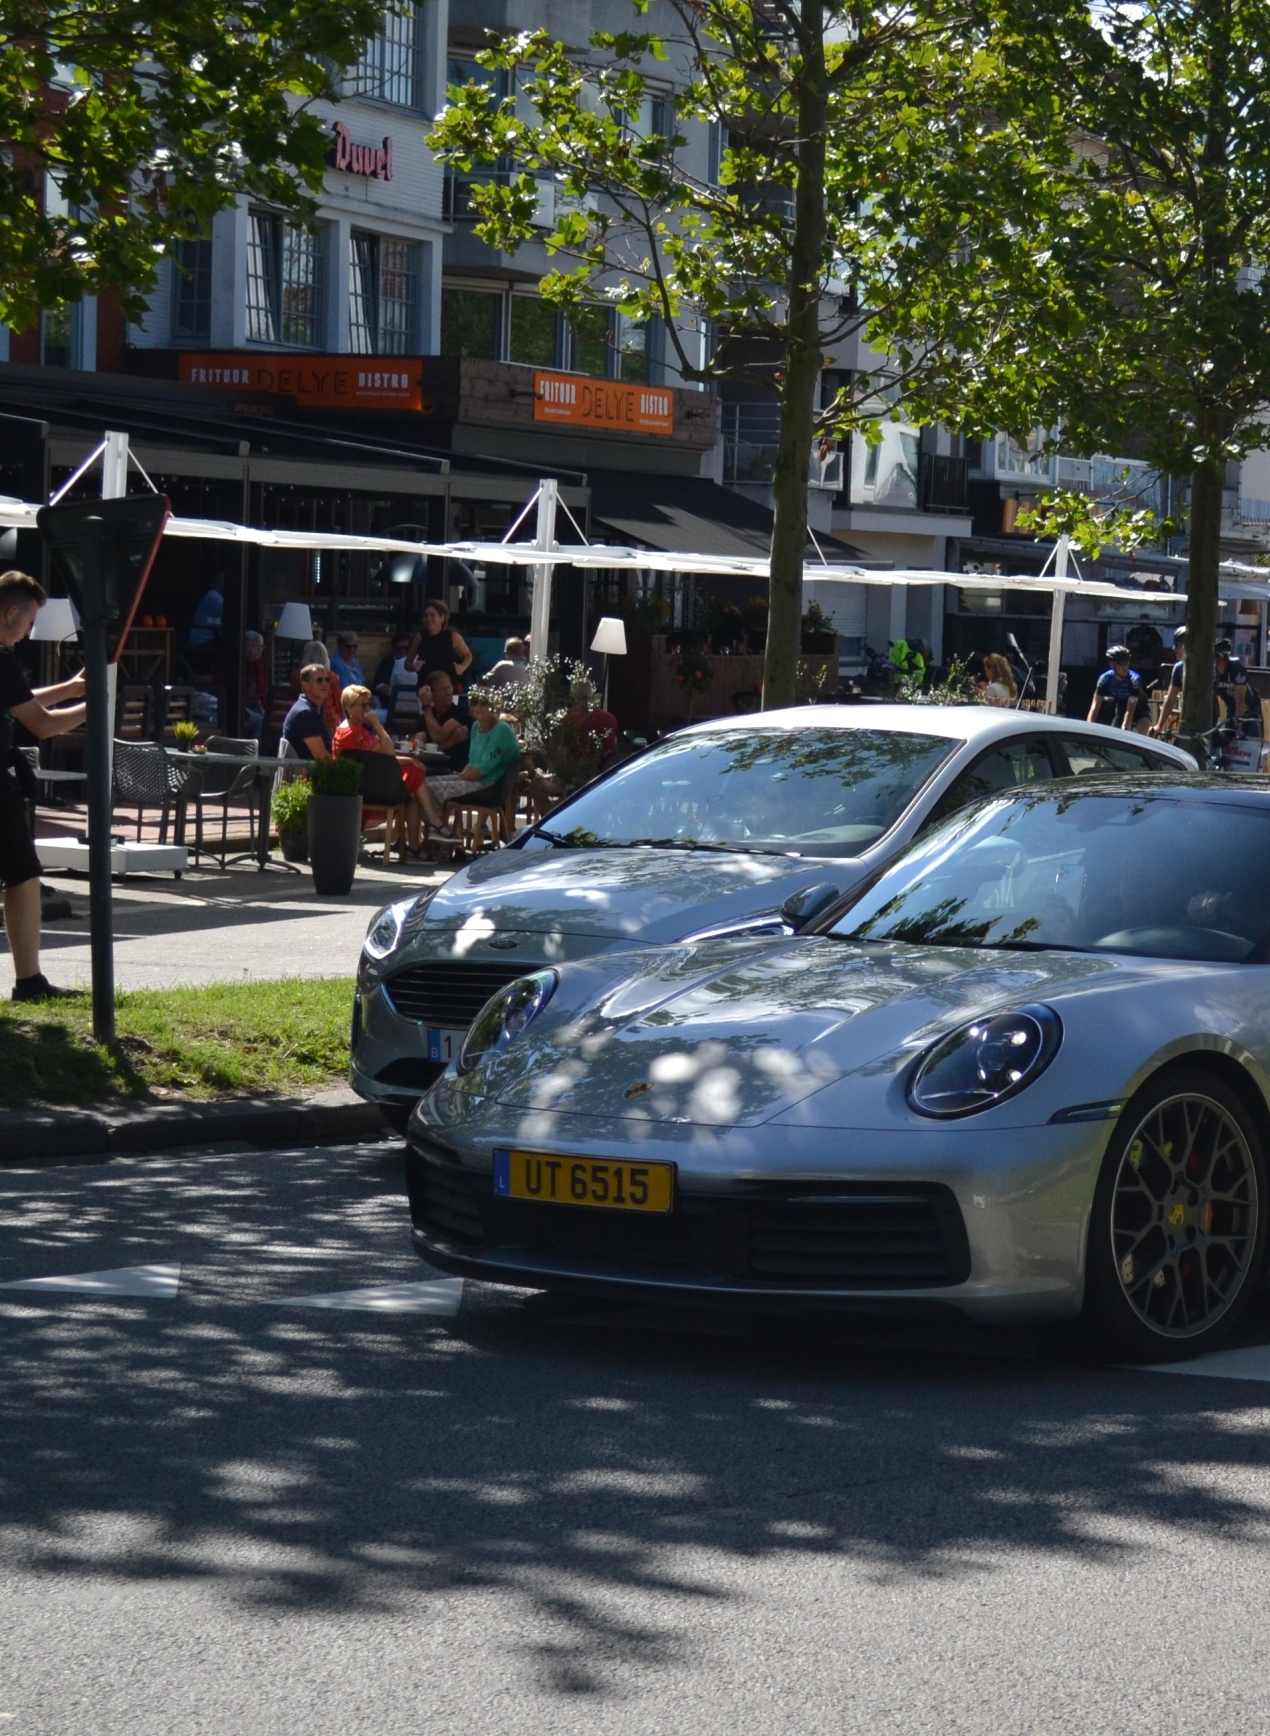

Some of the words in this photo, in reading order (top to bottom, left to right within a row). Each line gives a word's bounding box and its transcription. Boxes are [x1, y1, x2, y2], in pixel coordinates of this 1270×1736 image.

[331, 121, 393, 181] Duvel
[191, 368, 249, 384] FRITUUR
[257, 369, 348, 395] DELYE
[358, 373, 408, 389] BISTRO
[540, 379, 576, 405] FRITUUR
[582, 385, 635, 422] DELYE
[640, 394, 669, 416] BISTRO
[431, 1047, 439, 1058] B
[499, 1176, 505, 1188] L
[525, 1158, 561, 1196] UT
[571, 1163, 648, 1205] 6515
